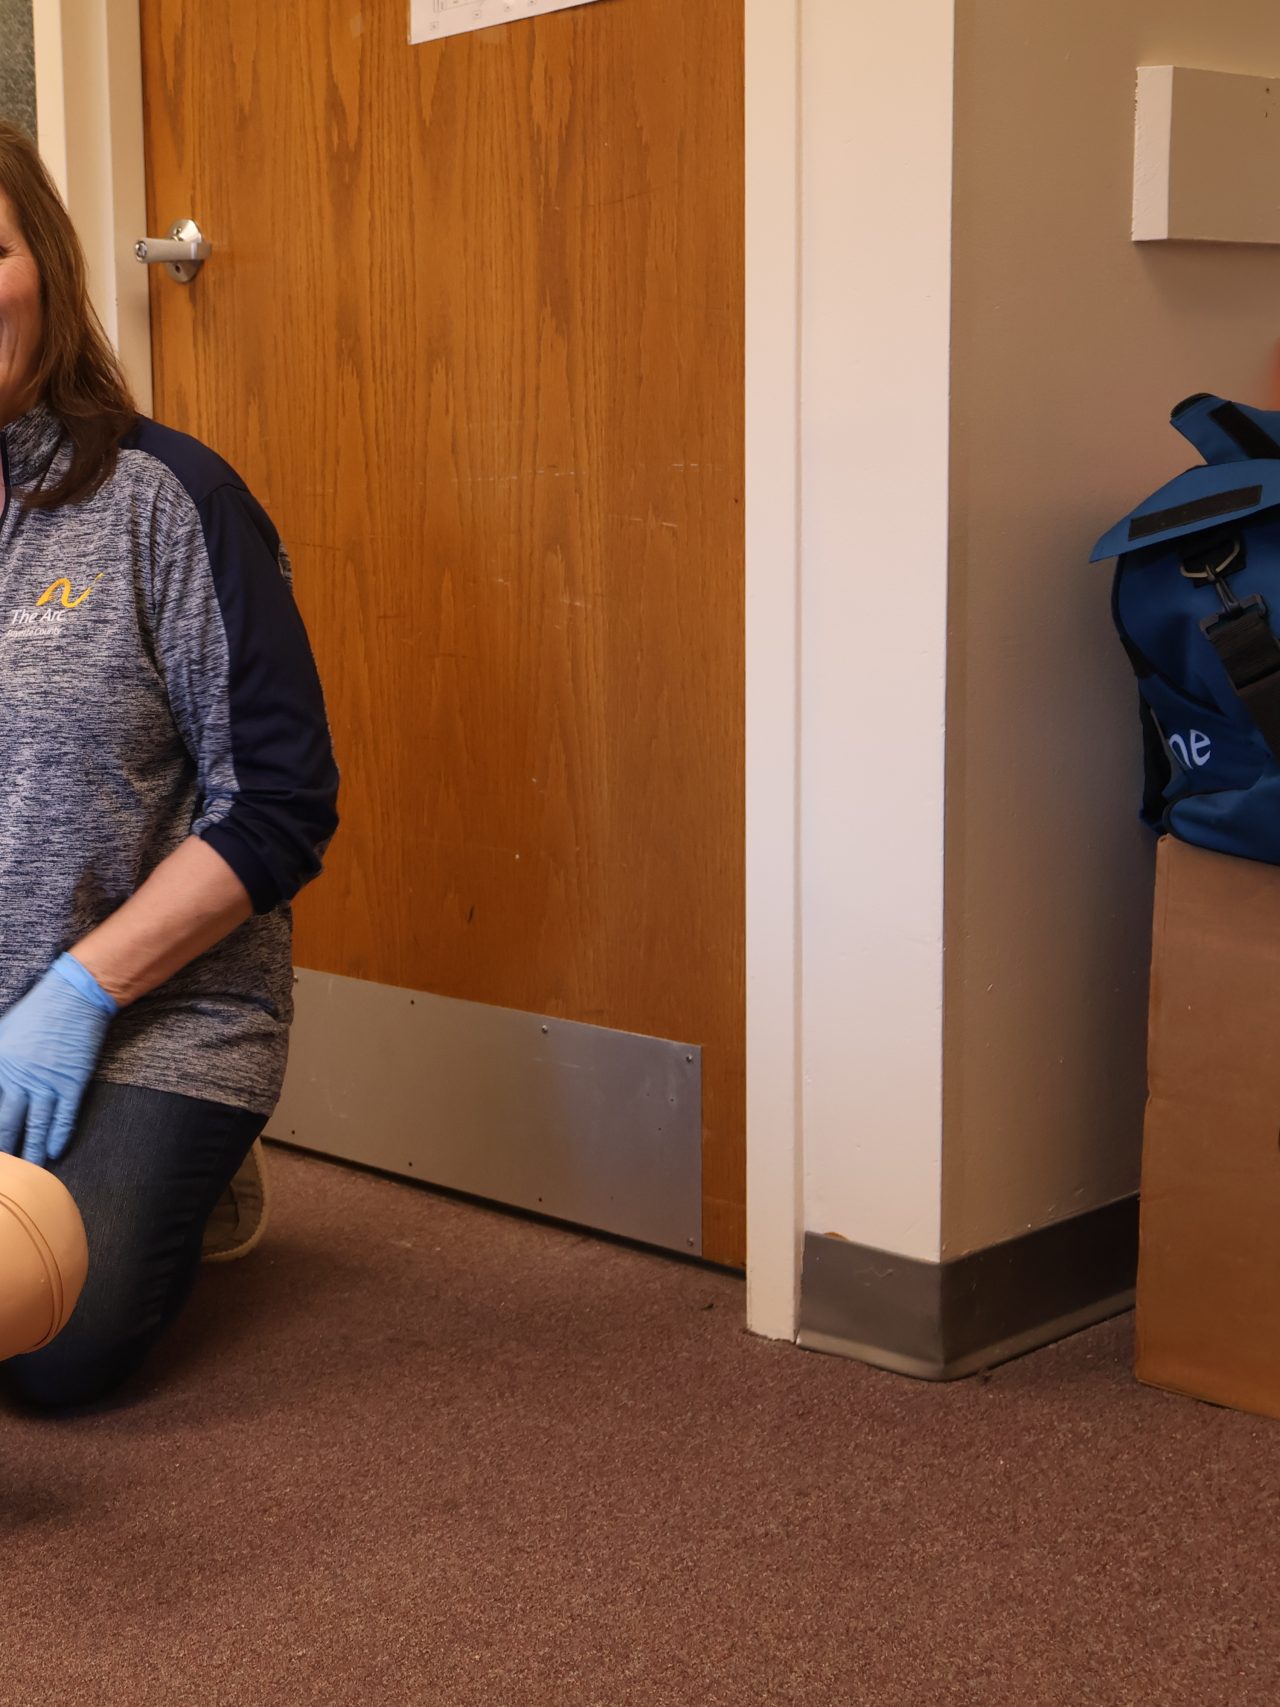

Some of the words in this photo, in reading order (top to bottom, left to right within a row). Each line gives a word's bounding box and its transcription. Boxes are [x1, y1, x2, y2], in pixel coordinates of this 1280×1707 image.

[11, 608, 38, 624] The
[40, 608, 66, 622] Arc
[34, 626, 63, 637] County
